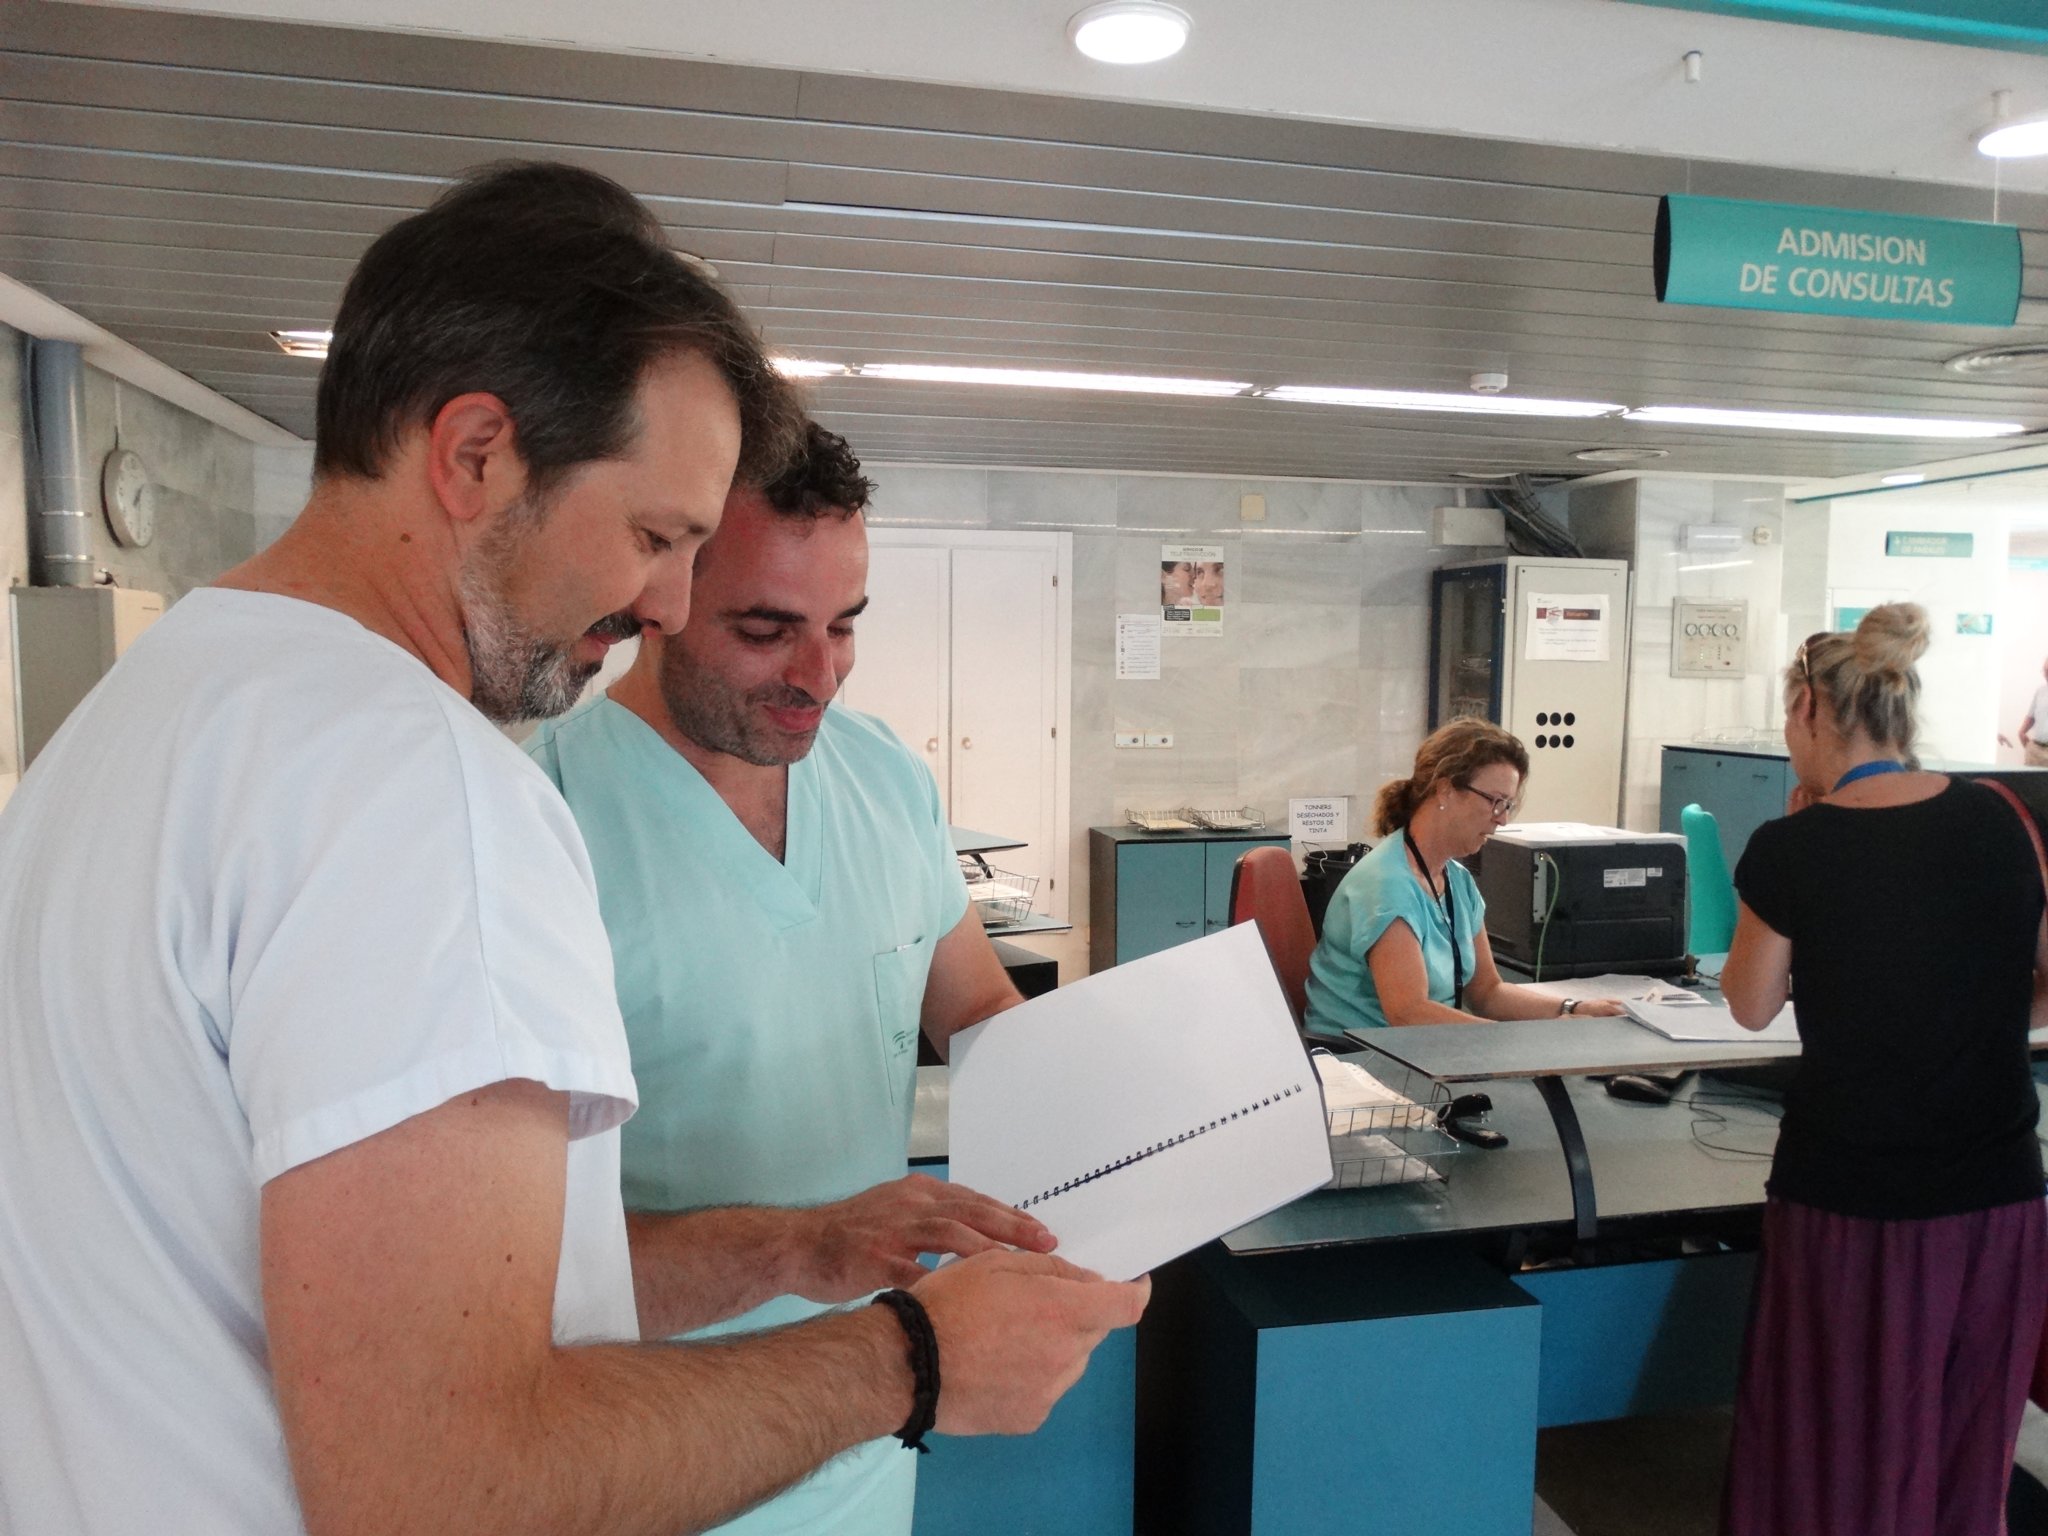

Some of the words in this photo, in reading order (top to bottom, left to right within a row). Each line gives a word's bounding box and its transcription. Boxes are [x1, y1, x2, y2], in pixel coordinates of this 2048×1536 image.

[1776, 226, 1927, 267] ADMISION
[1738, 262, 1780, 295] DE
[1787, 266, 1955, 308] CONSULTAS
